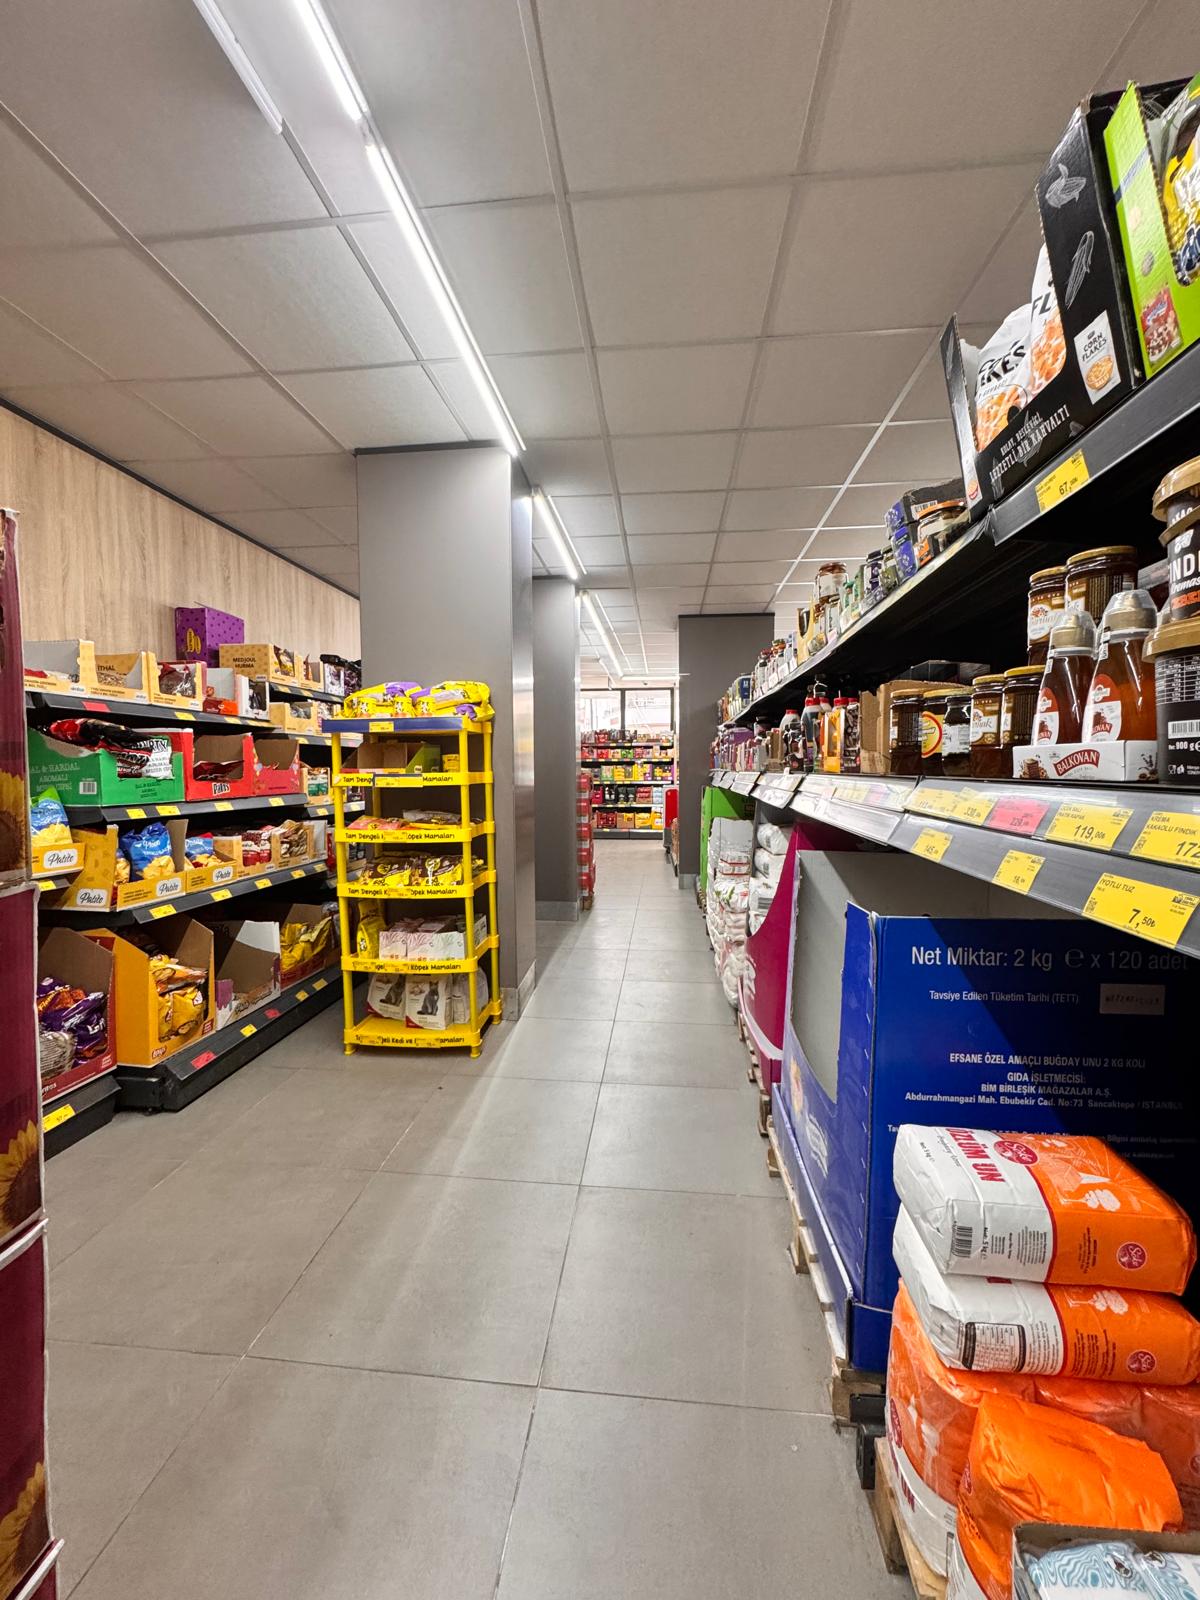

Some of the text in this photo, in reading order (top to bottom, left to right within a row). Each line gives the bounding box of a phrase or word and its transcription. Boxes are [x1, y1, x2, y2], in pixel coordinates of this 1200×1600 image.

[1082, 338, 1107, 361] FLAKES
[1083, 332, 1103, 352] CORN
[1030, 404, 1070, 446] KAHVALTI
[1056, 751, 1098, 775] BALKOVAN
[1147, 824, 1172, 832] KAKAOLU
[1122, 885, 1135, 894] TUZ
[912, 946, 941, 965] Net
[948, 947, 1008, 966] Miktar:
[1014, 949, 1025, 967] 2
[1031, 949, 1053, 972] kg
[1090, 954, 1101, 969] x
[1108, 950, 1142, 970] 120
[929, 990, 960, 1002] Tavsiye
[962, 991, 988, 1001] Edilen
[990, 992, 1024, 1002] Tüketim
[1027, 992, 1050, 1002] Tarihi
[950, 1053, 982, 1064] EFSANE
[984, 1052, 1006, 1064] ÖZEL
[1008, 1054, 1041, 1068] AMAÇLI
[1043, 1054, 1080, 1067] BUĞDAY
[1082, 1057, 1102, 1068] UNU
[1103, 1058, 1110, 1068] 2
[1111, 1058, 1124, 1068] KG
[1007, 1072, 1028, 1082] GIDA
[981, 1082, 997, 1092] BİM
[999, 1082, 1036, 1095] BİRLEŞİK
[1038, 1084, 1092, 1096] MAĞAZALAR
[905, 1092, 976, 1104] Abdurrahmangazi
[978, 1095, 997, 1104] Mah.
[1000, 1096, 1035, 1106] Ebubekir
[1037, 1097, 1055, 1106] Cad.
[972, 1163, 1006, 1182] UN
